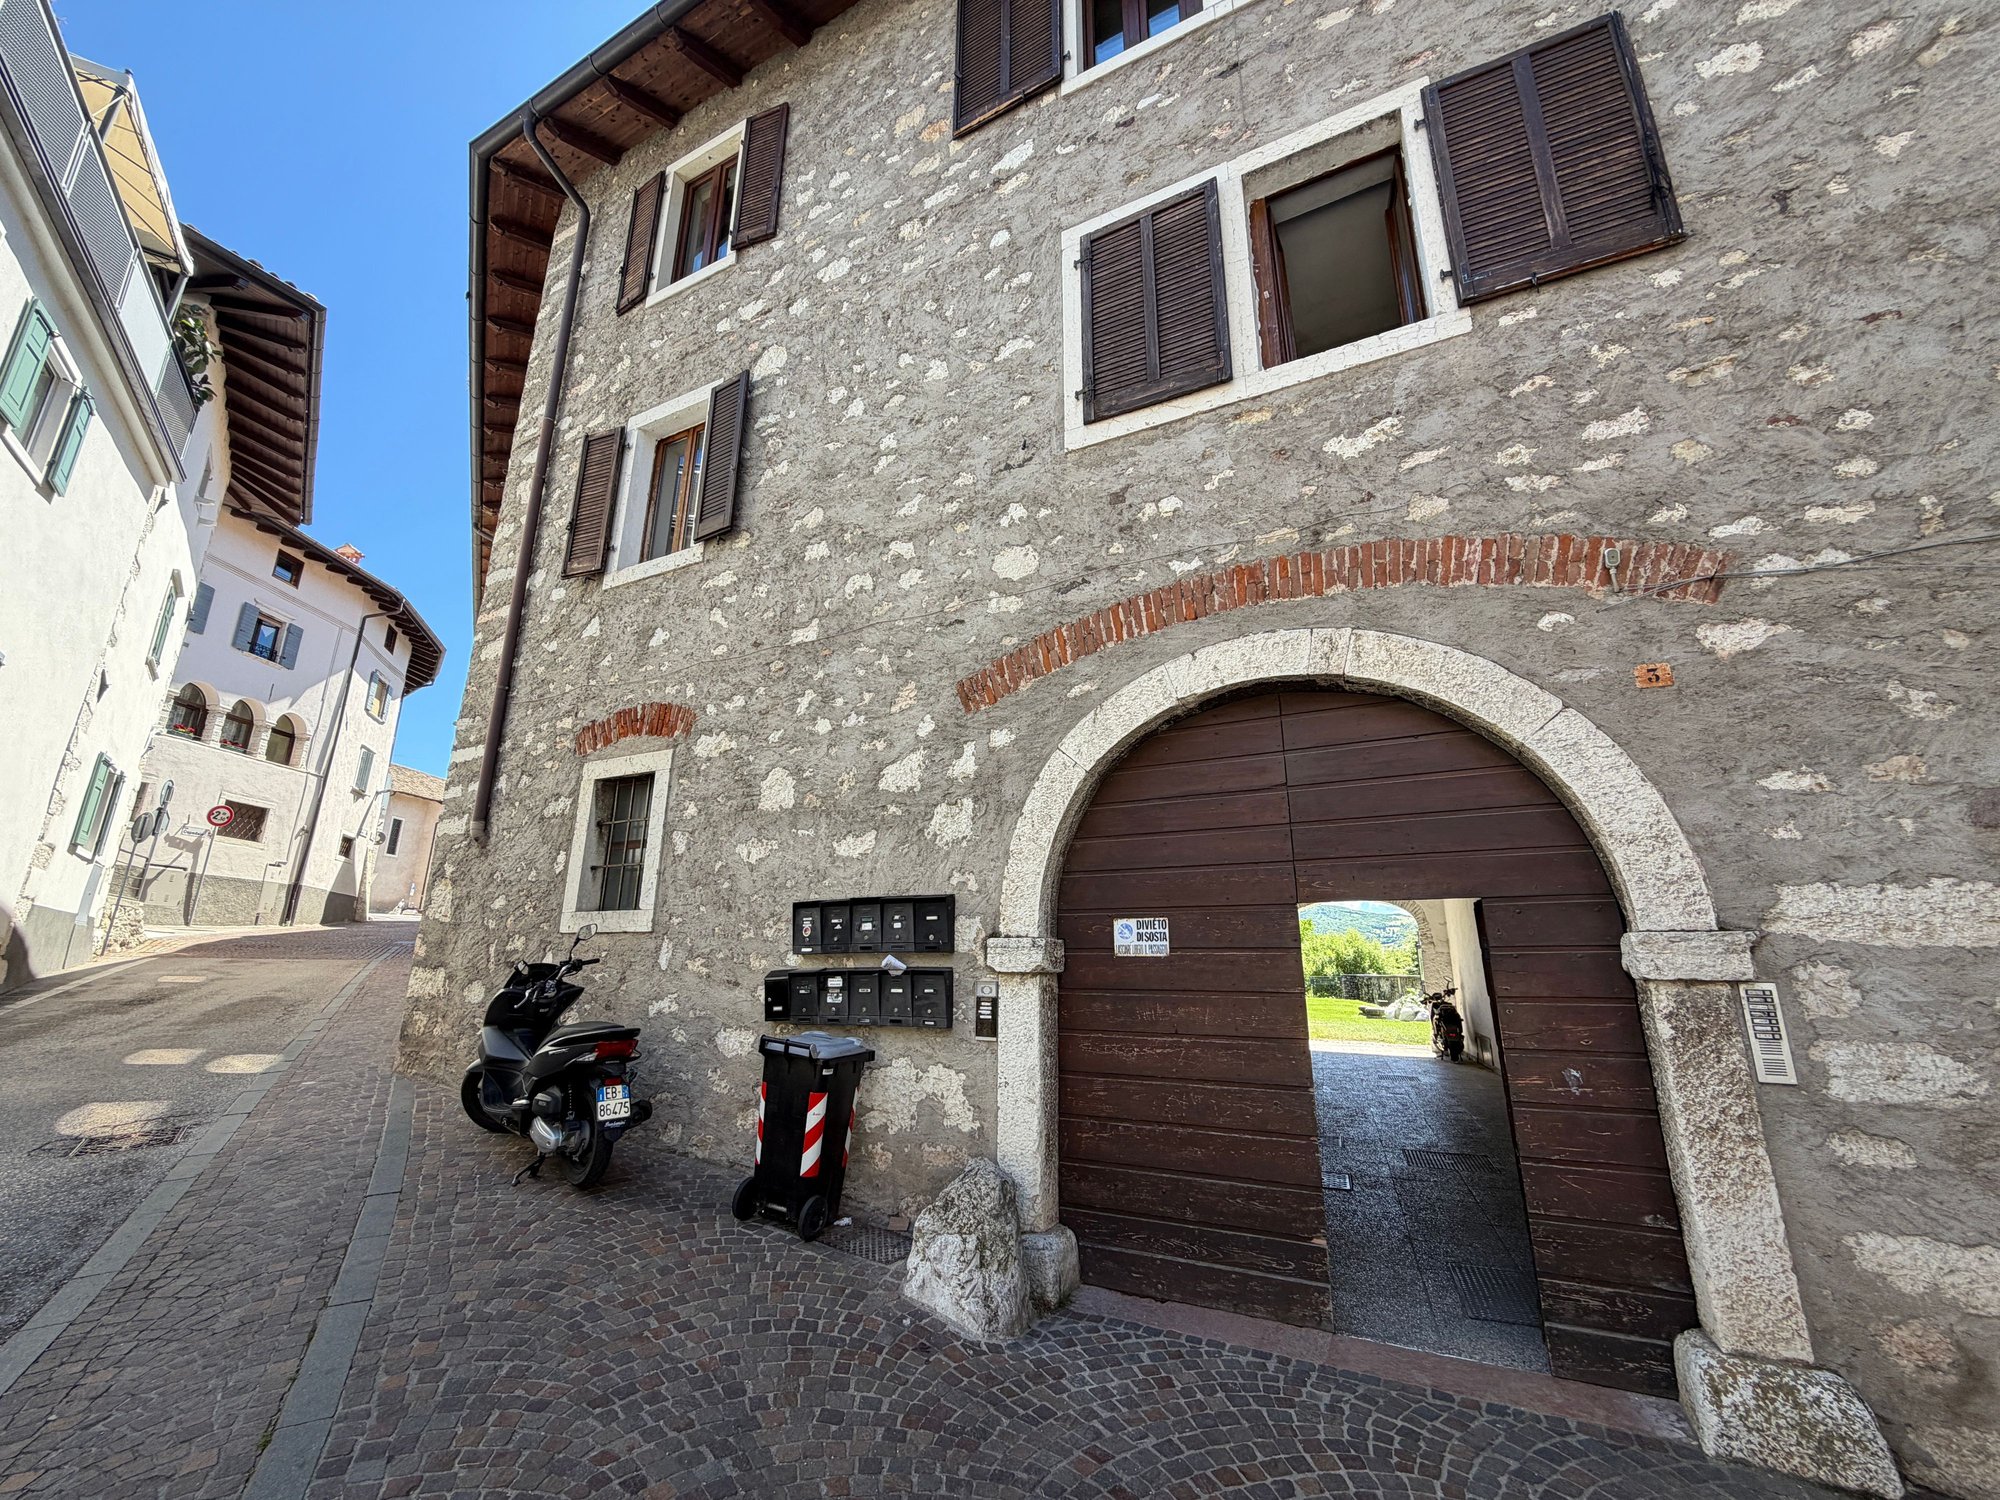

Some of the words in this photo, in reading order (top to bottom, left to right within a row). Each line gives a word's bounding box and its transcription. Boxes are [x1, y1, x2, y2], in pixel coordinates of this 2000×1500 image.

[1646, 667, 1660, 683] 3
[1136, 919, 1167, 930] DIVIETO
[1136, 932, 1144, 942] DI
[1144, 931, 1168, 942] SOSTA
[605, 1086, 618, 1099] EB
[599, 1101, 630, 1117] 86475
